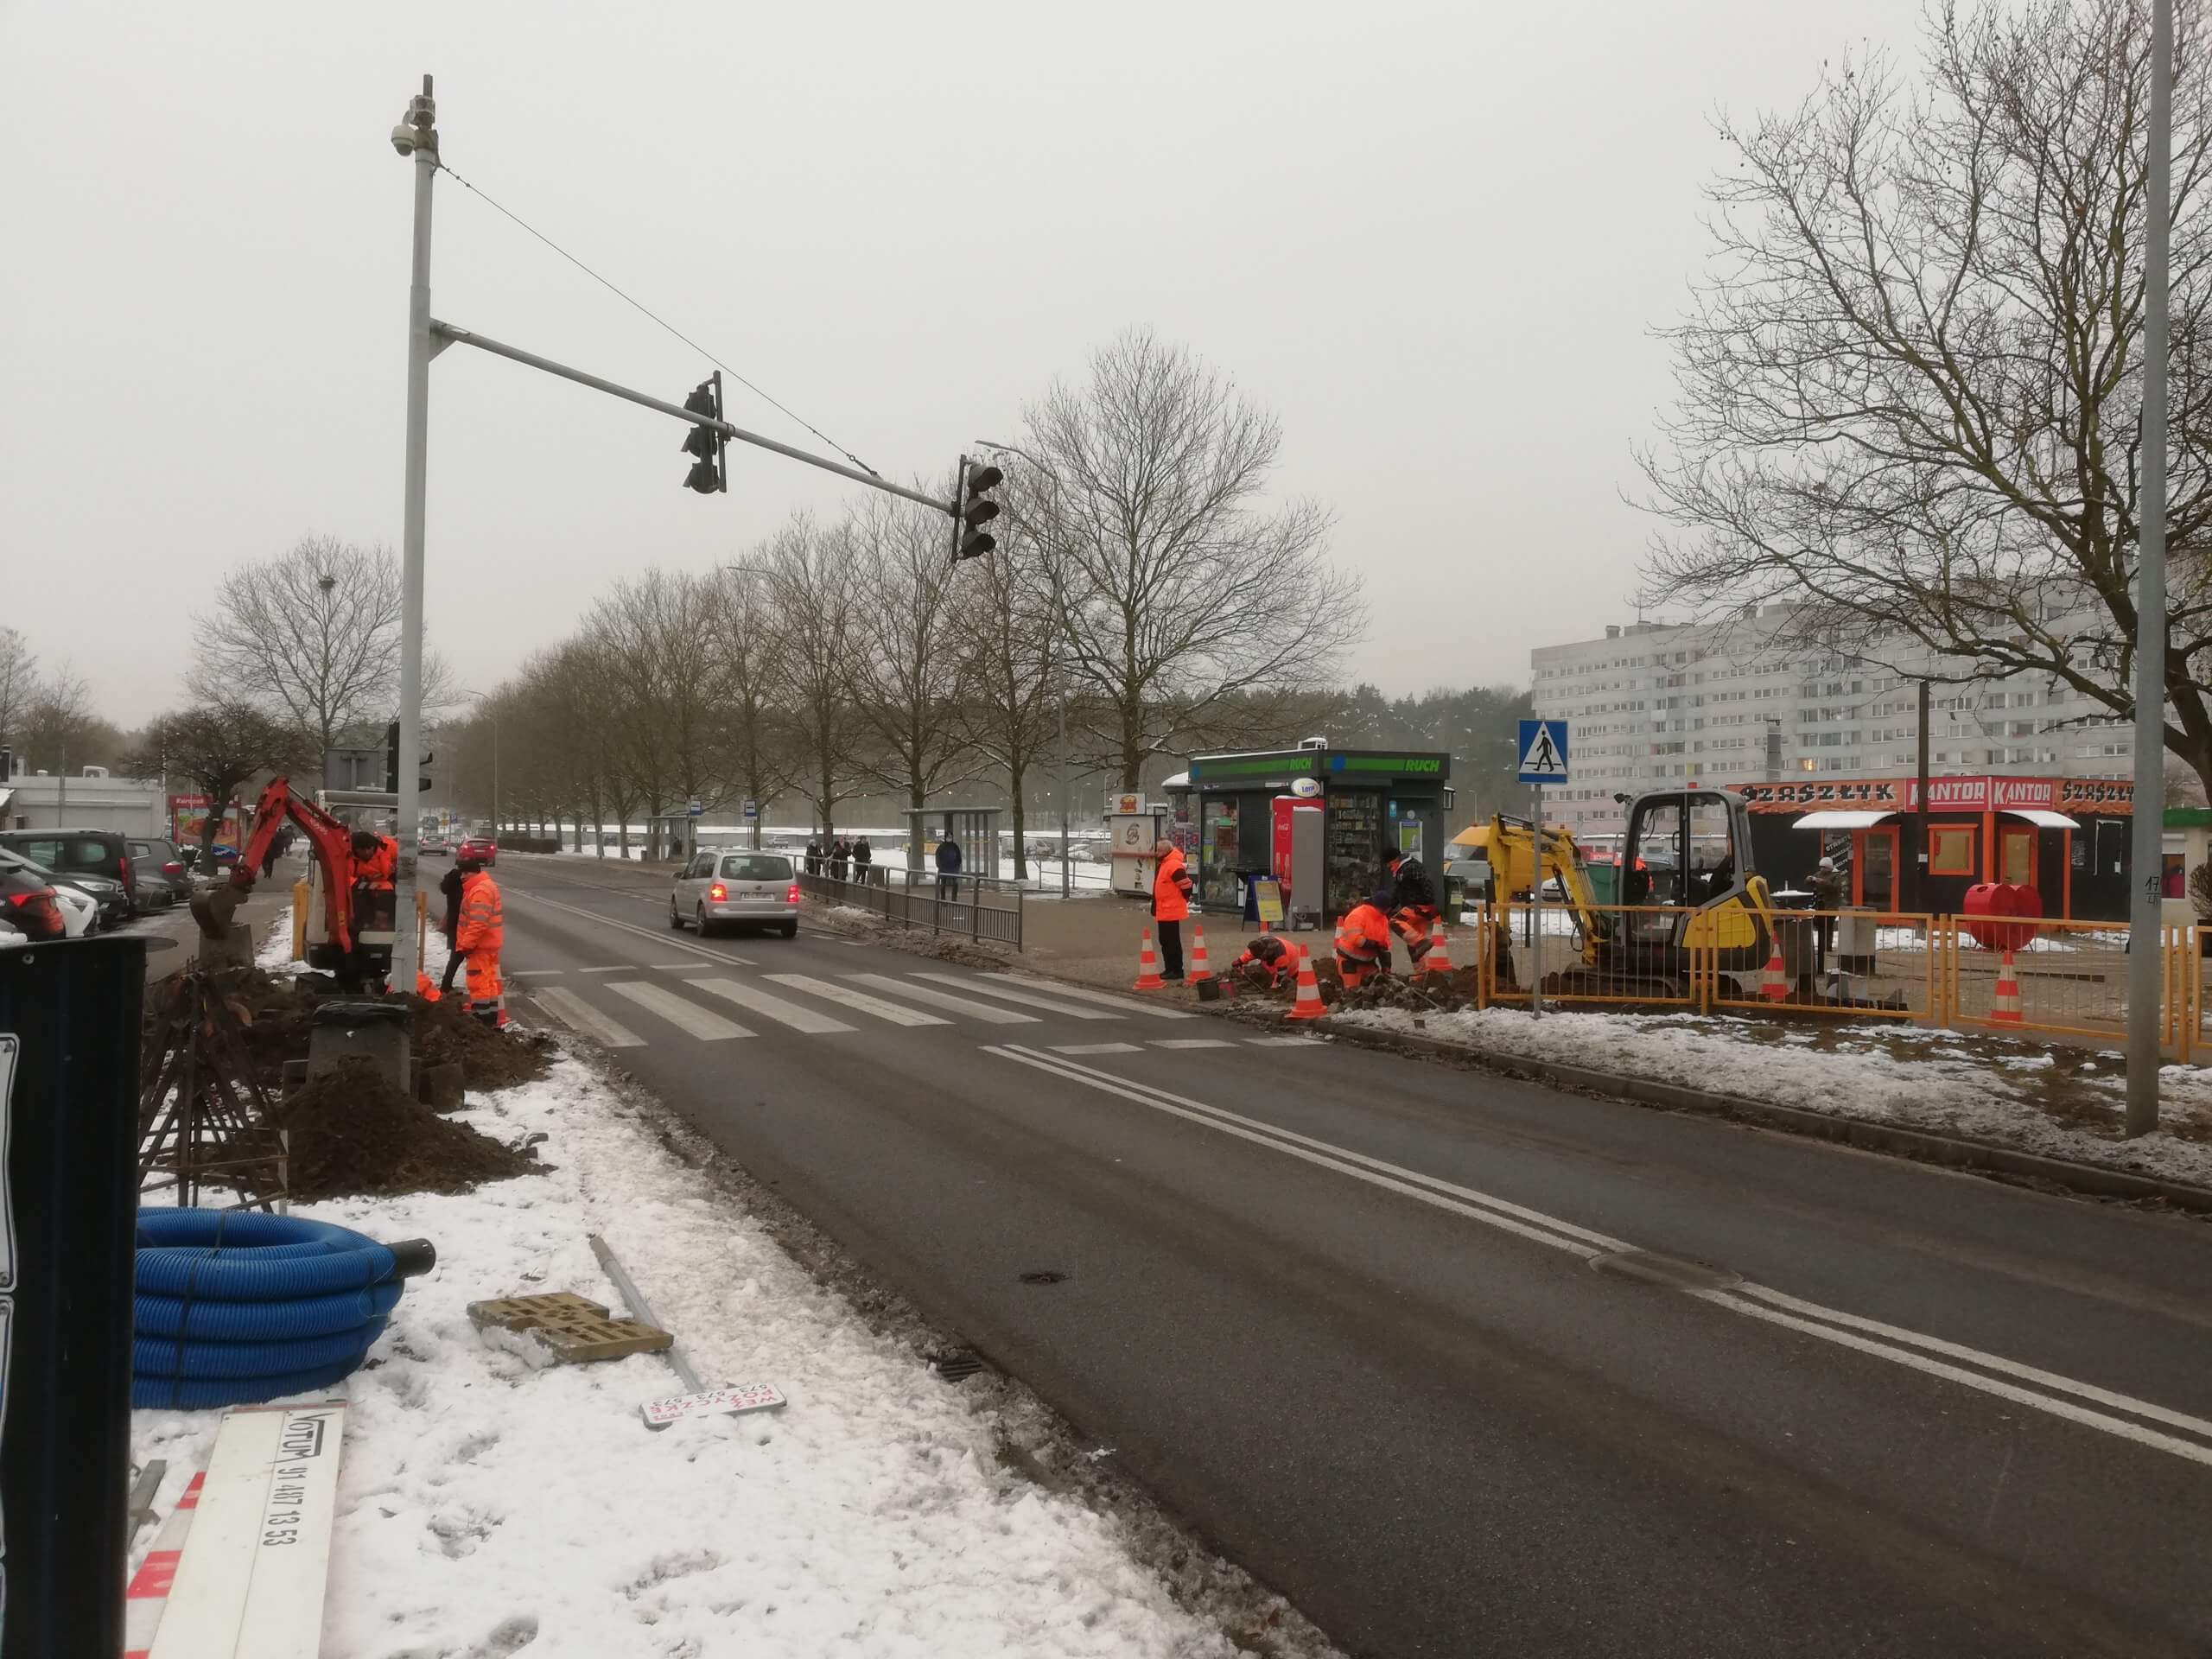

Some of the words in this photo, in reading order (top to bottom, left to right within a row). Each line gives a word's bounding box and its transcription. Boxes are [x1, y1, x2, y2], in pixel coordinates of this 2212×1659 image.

[1289, 757, 1313, 771] RUCH
[1404, 760, 1440, 772] RUCH
[1993, 781, 2051, 804] KANTOR
[2063, 780, 2134, 804] SZASZŁY
[2144, 875, 2160, 892] 17
[696, 1390, 726, 1400] 573
[739, 1384, 768, 1393] 573
[652, 1397, 683, 1407] 573
[266, 1412, 336, 1465] VOTUM
[277, 1467, 308, 1480] 91
[271, 1484, 305, 1505] 487
[267, 1510, 301, 1526] 13
[262, 1529, 298, 1547] 53
